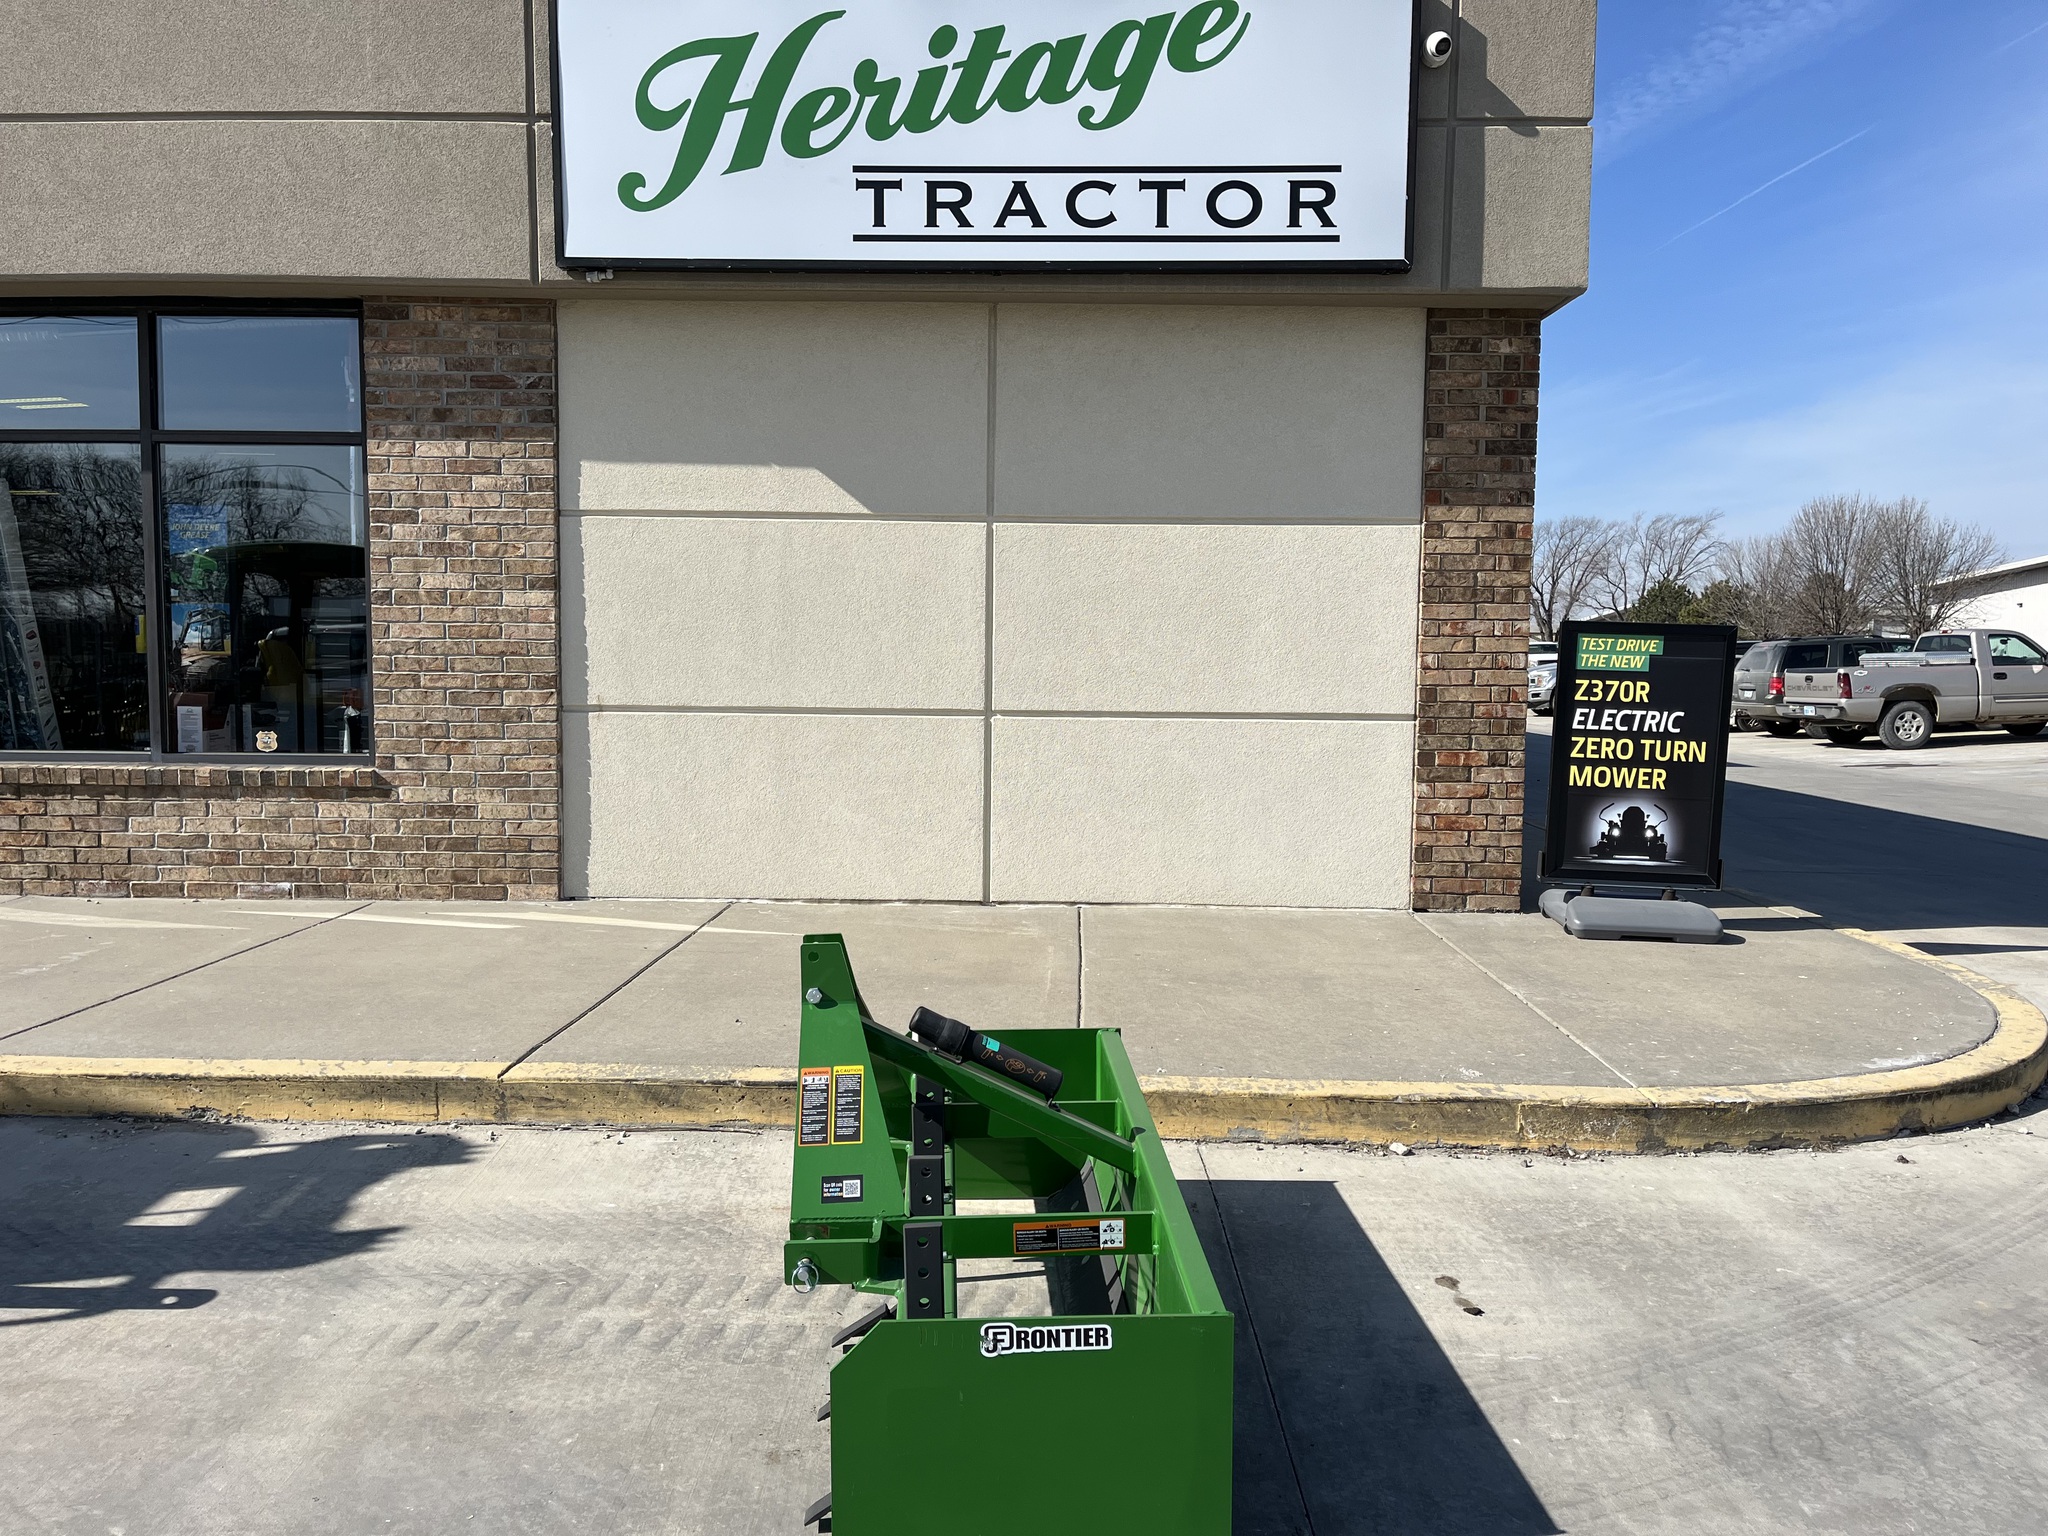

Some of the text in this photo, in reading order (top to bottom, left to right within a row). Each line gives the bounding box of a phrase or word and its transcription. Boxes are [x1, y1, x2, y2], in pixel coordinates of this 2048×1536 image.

[617, 0, 1251, 212] Heritage
[855, 179, 1340, 230] TRACTOR
[1582, 637, 1659, 653] TEST DRIVE
[1580, 654, 1646, 669] THE NEW
[1574, 679, 1650, 703] Z370R
[1571, 708, 1684, 733] ELECTRIC
[1570, 737, 1706, 763] ZERO TURN
[1568, 765, 1667, 790] MOWER
[984, 1325, 1109, 1353] FRONTIER
